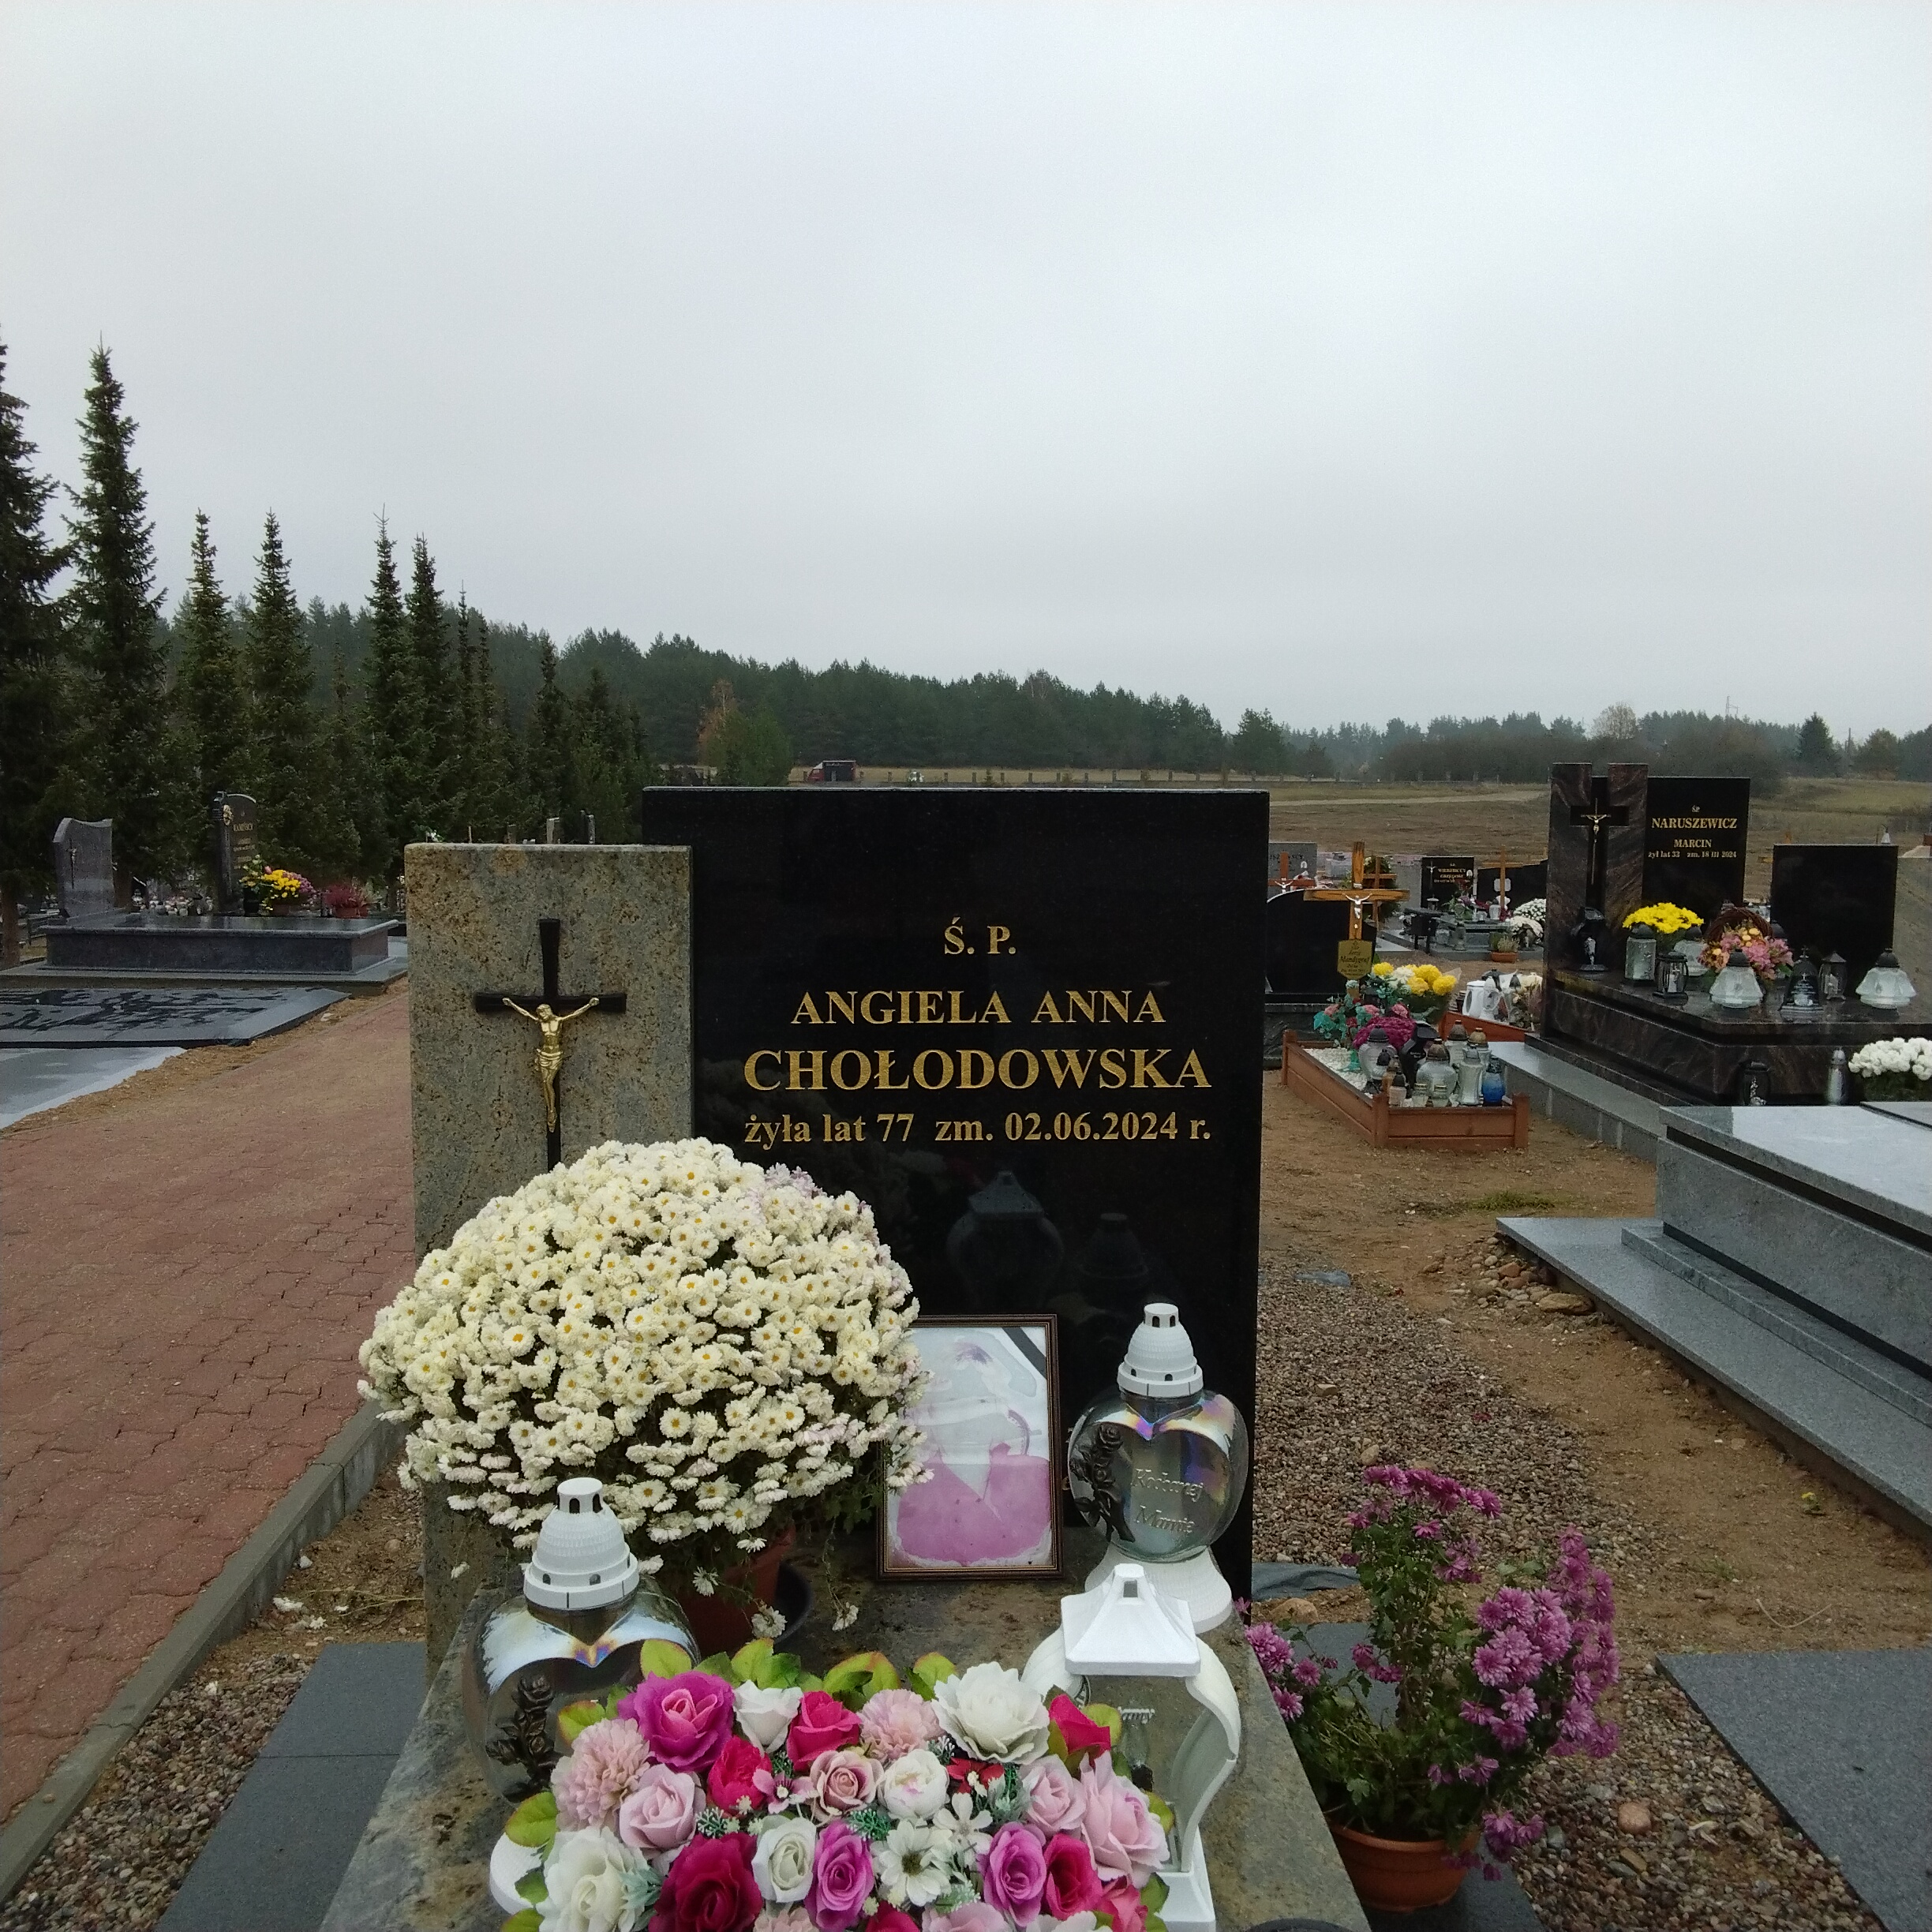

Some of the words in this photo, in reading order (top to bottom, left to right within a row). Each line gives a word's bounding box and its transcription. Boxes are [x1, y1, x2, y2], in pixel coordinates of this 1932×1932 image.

[1651, 817, 1738, 829] NARUSZEWICZ
[1673, 839, 1712, 848] MARCIN
[945, 917, 974, 954] Ś.
[987, 927, 1016, 954] P.
[791, 991, 1012, 1024] ANGIELA
[1031, 991, 1166, 1023] ANNA
[744, 1049, 1211, 1090] CHOŁODOWSKA
[745, 1114, 811, 1150] żyła
[823, 1114, 866, 1141] lat
[877, 1114, 914, 1141] 77
[935, 1121, 993, 1140] zm.
[1005, 1112, 1178, 1140] 02.06.2024
[1190, 1120, 1210, 1139] r.
[1134, 1504, 1195, 1533] Mamie
